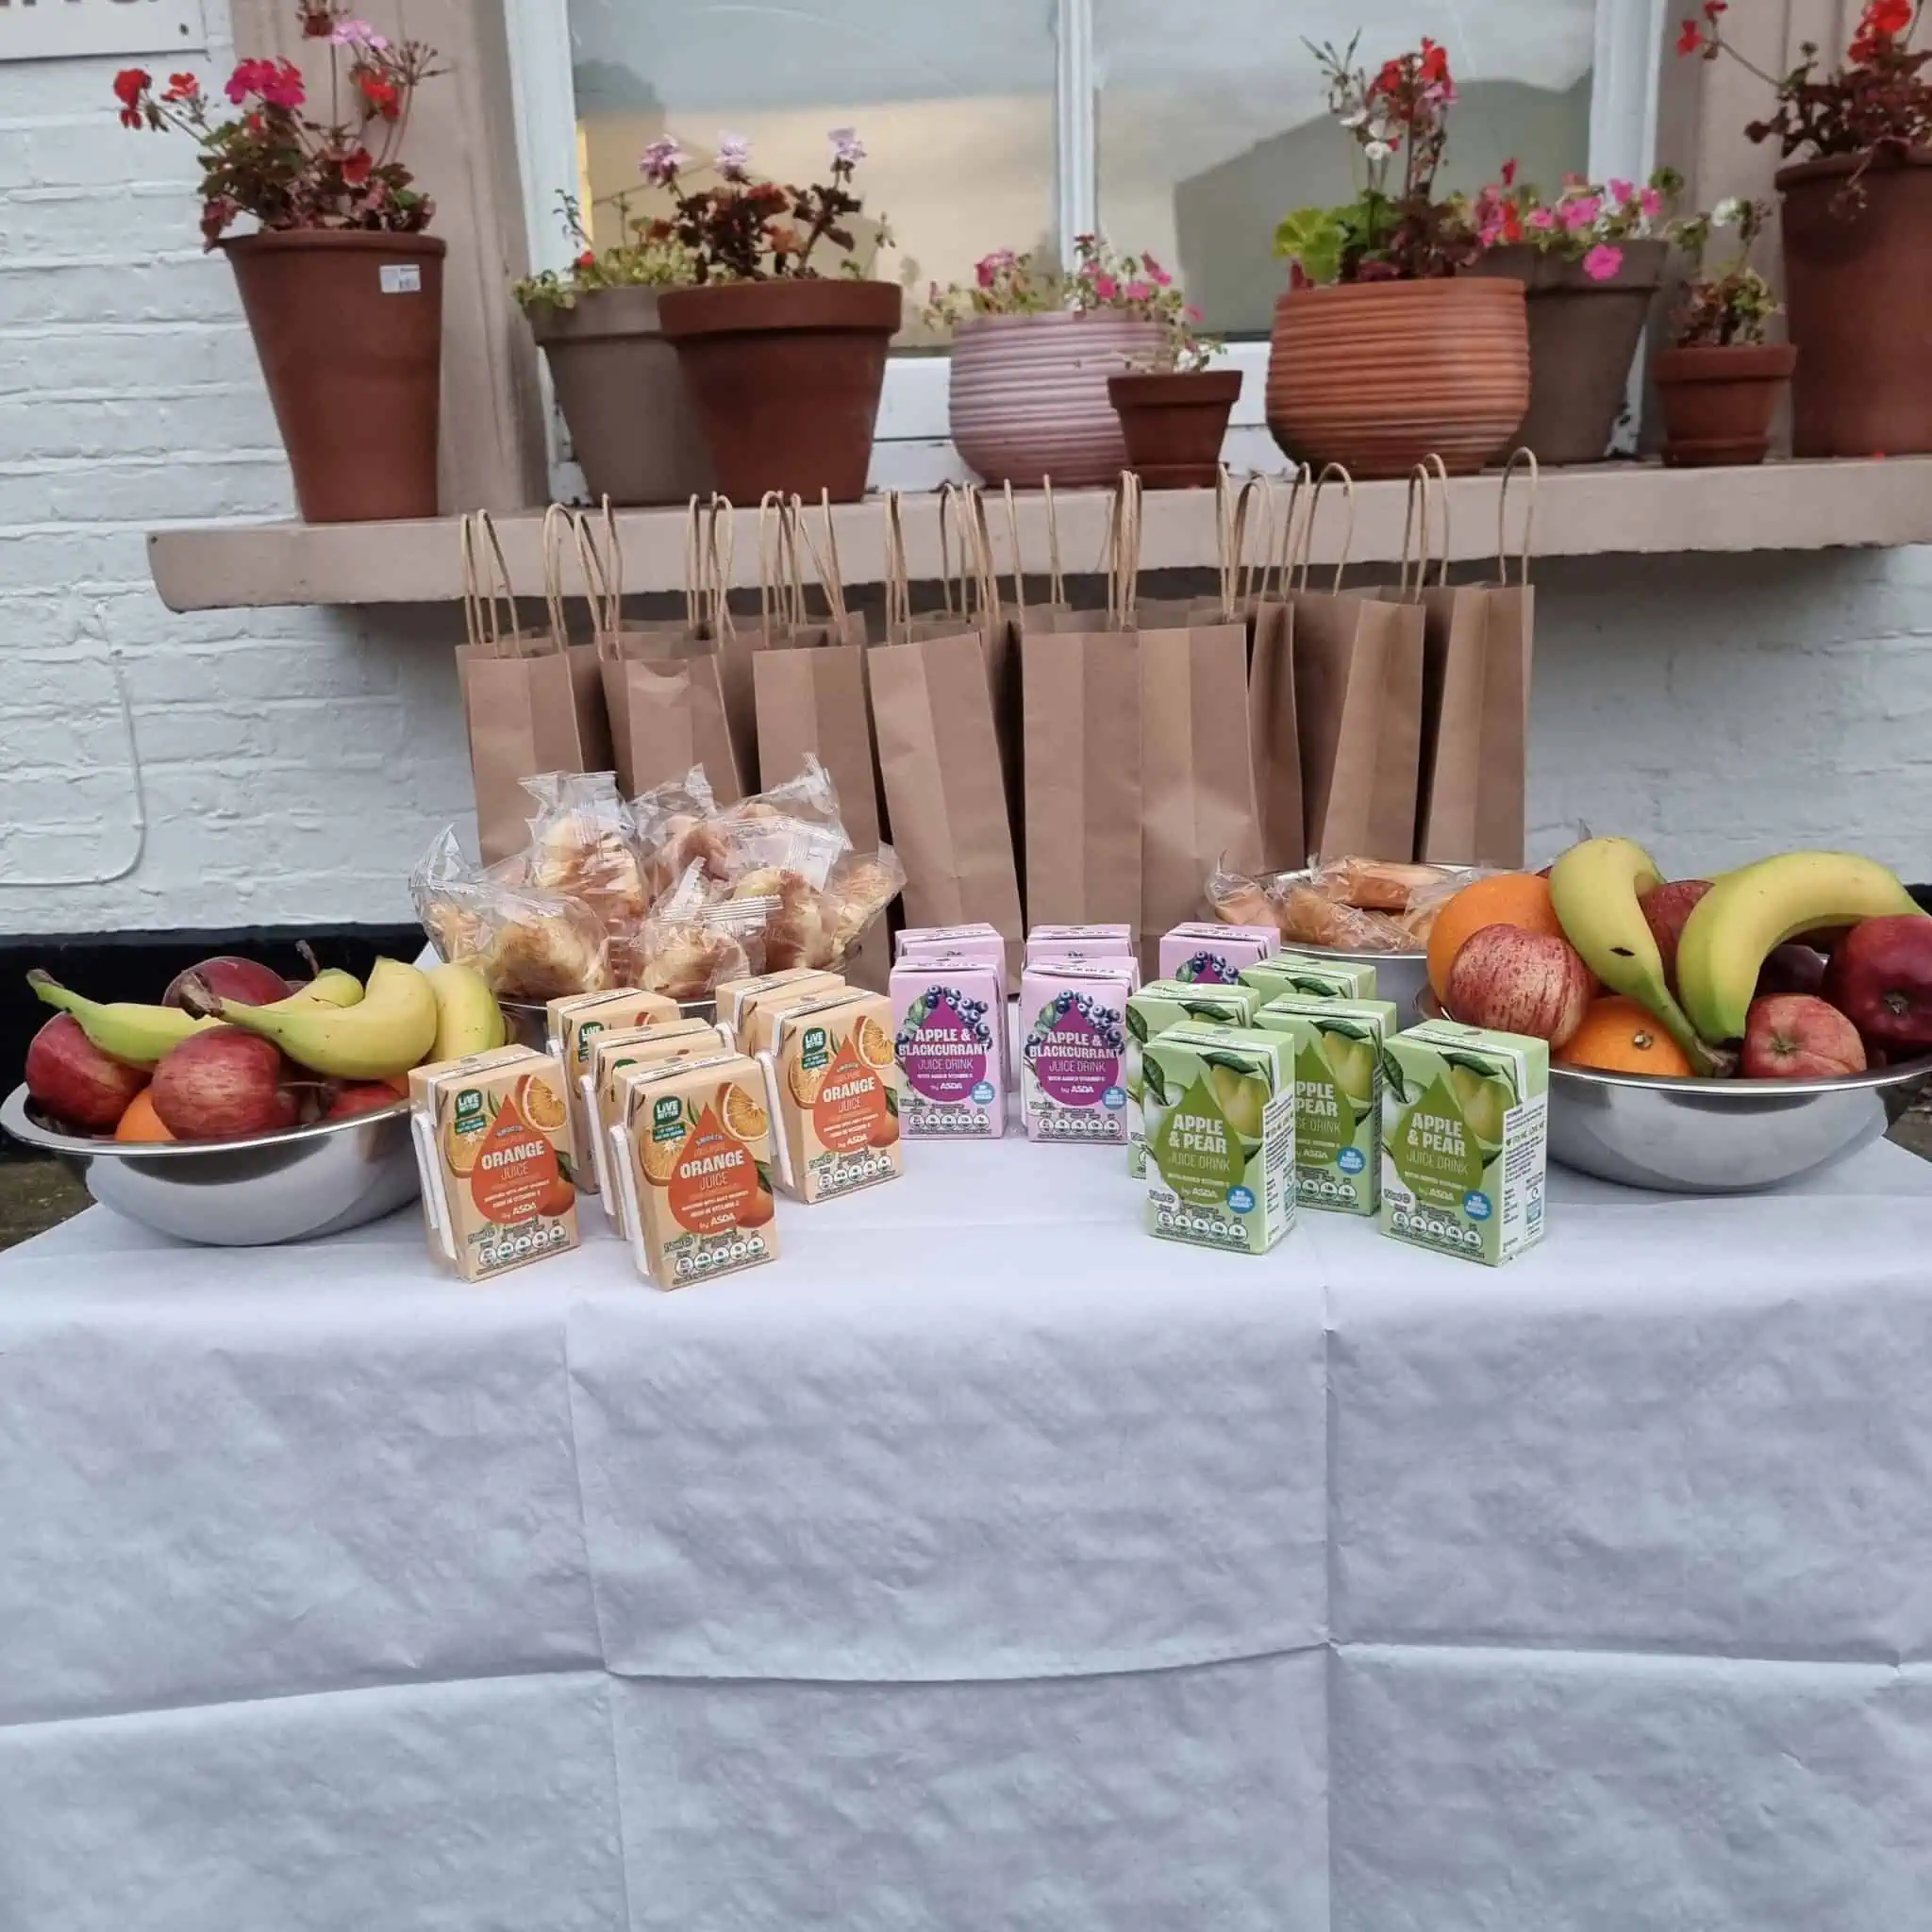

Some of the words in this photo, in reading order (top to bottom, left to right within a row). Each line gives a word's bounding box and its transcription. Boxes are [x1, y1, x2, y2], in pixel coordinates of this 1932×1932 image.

[805, 1031, 824, 1043] LIVE
[915, 1028, 958, 1041] APPLE
[960, 1028, 971, 1041] &
[1046, 1032, 1089, 1045] APPLE
[1092, 1035, 1102, 1046] &
[898, 1043, 989, 1056] BLACKCURRANT
[1029, 1045, 1121, 1058] BLACKCURRANT
[918, 1058, 943, 1070] JUICE
[945, 1058, 974, 1069] DRINK
[1049, 1059, 1075, 1073] JUICE
[1077, 1060, 1106, 1073] DRINK
[823, 1076, 875, 1102] ORANGE
[1071, 1085, 1094, 1093] ASDA
[1296, 1081, 1334, 1100] PPLE
[458, 1093, 479, 1105] LIVE
[838, 1096, 860, 1113] JUICE
[657, 1100, 678, 1114] LIVE
[1295, 1098, 1338, 1117] PEAR
[1173, 1114, 1224, 1136] APPLE
[1310, 1118, 1341, 1134] DRINK
[1411, 1113, 1462, 1139] APPLE
[846, 1133, 868, 1144] ASDA
[1169, 1131, 1180, 1148] &
[1184, 1133, 1226, 1155] PEAR
[1407, 1128, 1419, 1146] &
[1423, 1132, 1465, 1157] PEAR
[481, 1140, 544, 1170] ORANGE
[1304, 1149, 1327, 1158] ASDA
[680, 1150, 744, 1178] ORANGE
[1169, 1152, 1196, 1167] JUICE
[1199, 1156, 1230, 1171] DRINK
[1407, 1150, 1434, 1167] JUICE
[1438, 1157, 1469, 1176] DRINK
[501, 1161, 528, 1181] JUICE
[700, 1172, 728, 1191] JUICE
[1428, 1189, 1454, 1201] ASDA
[512, 1202, 536, 1215] ASDA
[710, 1213, 736, 1226] ASDA
